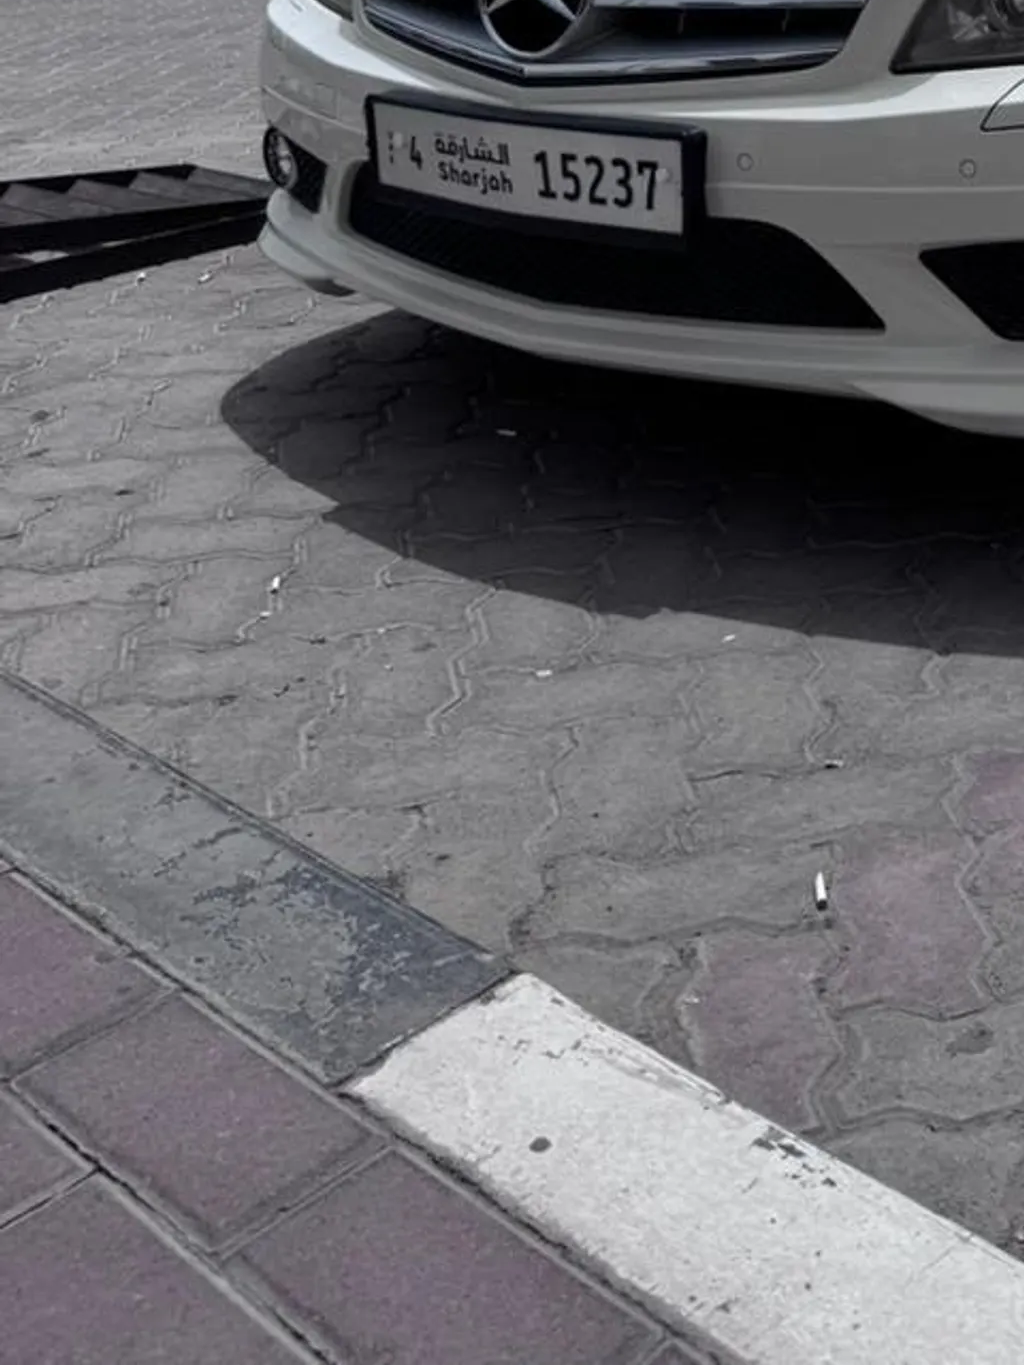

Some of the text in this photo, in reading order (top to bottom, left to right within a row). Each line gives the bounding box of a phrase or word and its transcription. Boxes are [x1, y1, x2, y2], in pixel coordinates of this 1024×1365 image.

[409, 135, 423, 171] 4
[434, 131, 511, 166] الشارقة
[438, 160, 513, 196] Sharjah
[534, 150, 659, 211] 15237
